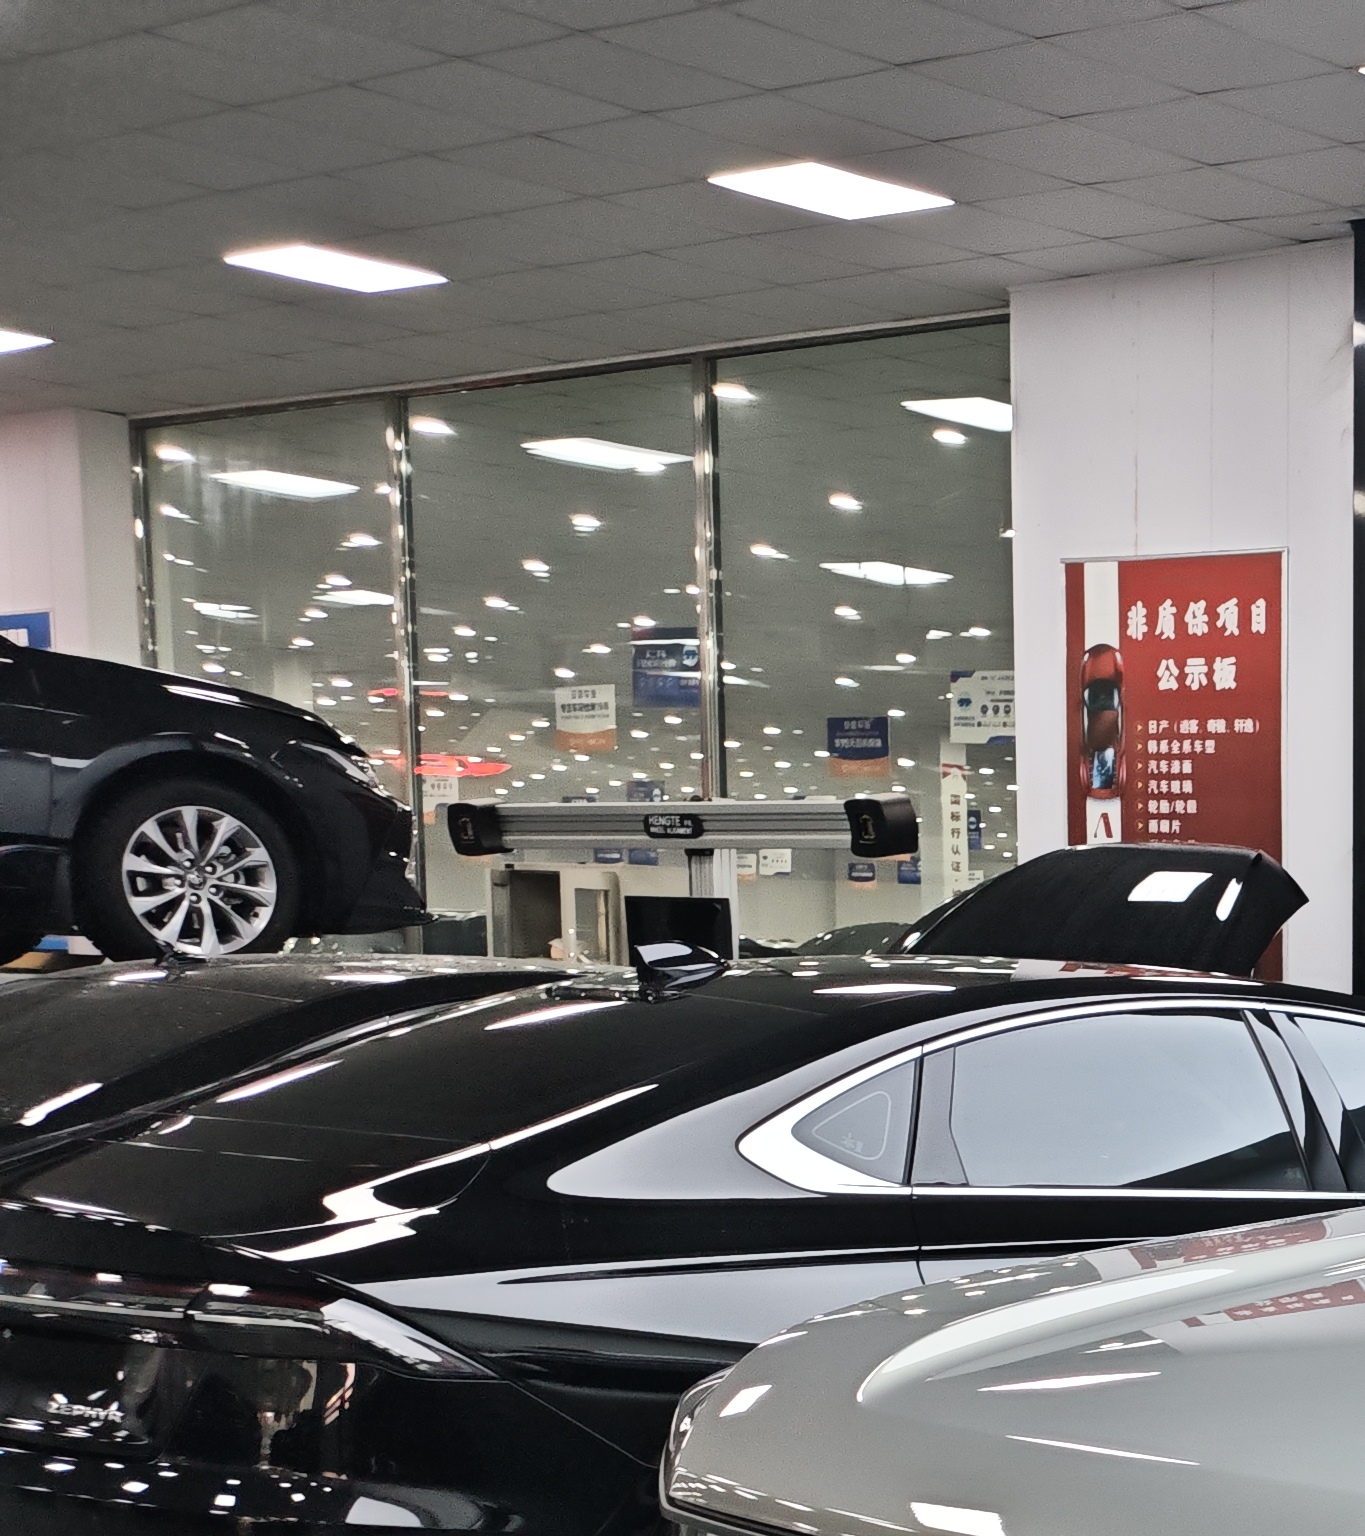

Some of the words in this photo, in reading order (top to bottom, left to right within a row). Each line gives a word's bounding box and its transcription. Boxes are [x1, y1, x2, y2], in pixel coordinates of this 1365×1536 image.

[1127, 598, 1267, 641] 非质保项目
[1156, 656, 1237, 691] 公示板
[46, 1400, 126, 1423] ZEPHYR
